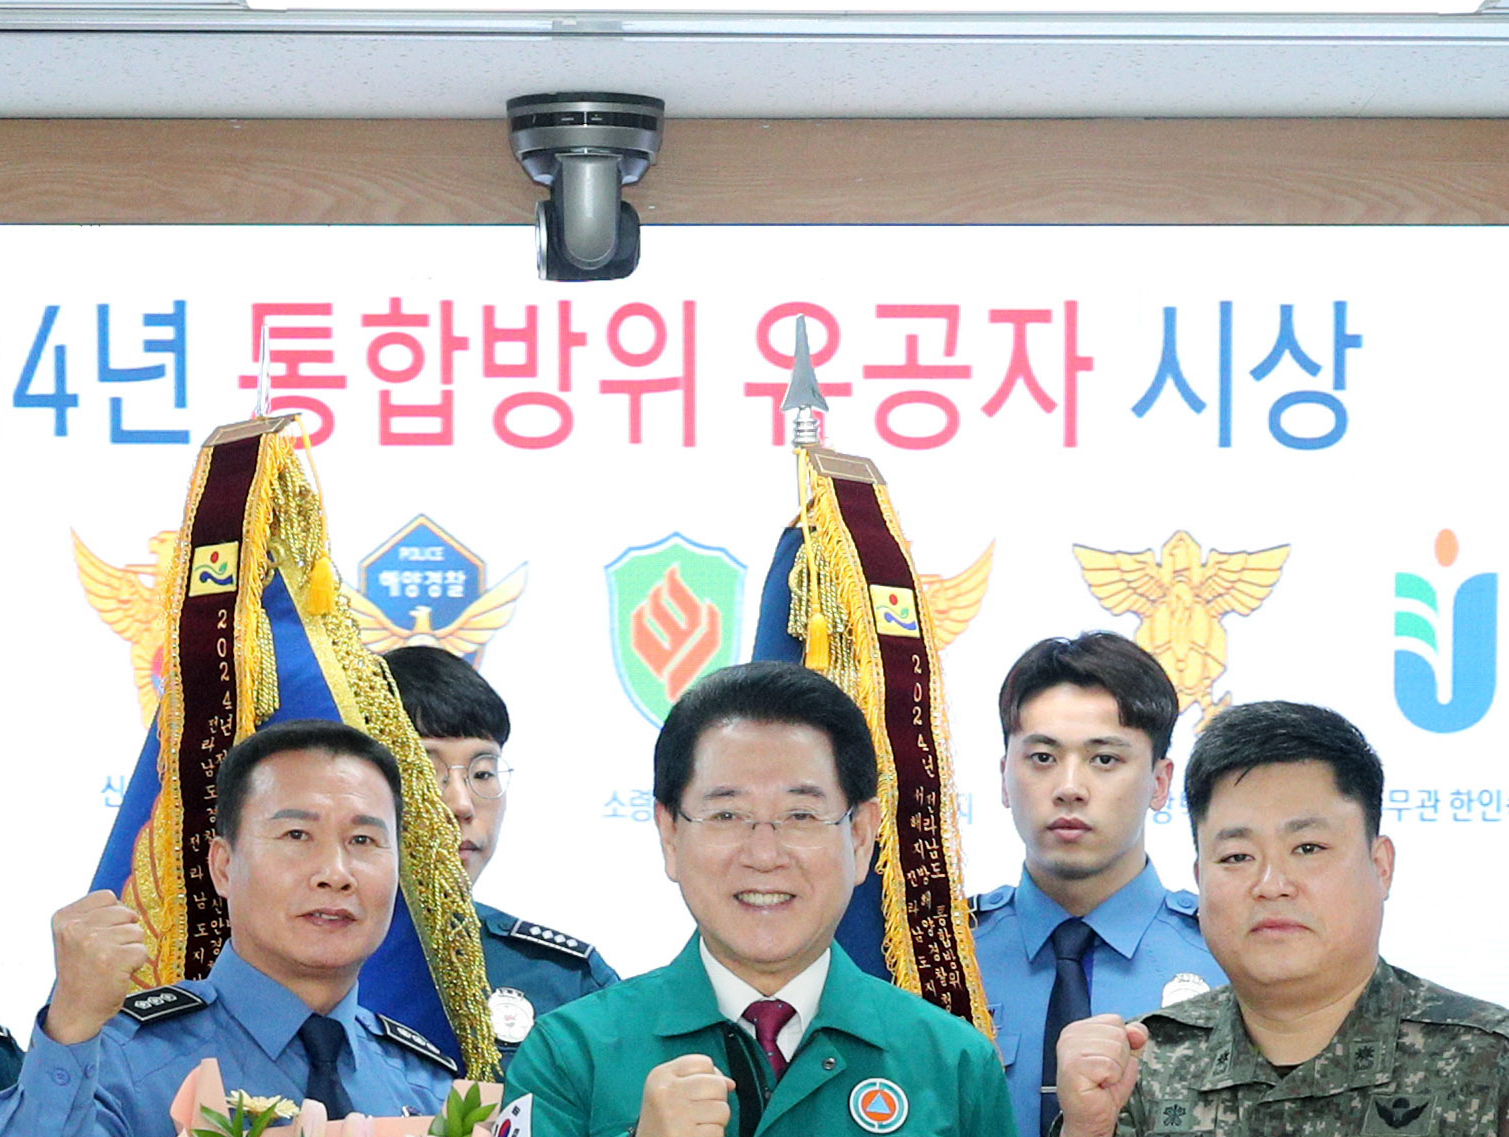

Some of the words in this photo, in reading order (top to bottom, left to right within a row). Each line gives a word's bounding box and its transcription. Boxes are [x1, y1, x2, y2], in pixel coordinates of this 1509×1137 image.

[237, 297, 698, 449] 통합방위
[743, 299, 1094, 450] 유공자
[1130, 299, 1363, 450] 시상
[378, 569, 467, 598] 해양경찰
[397, 546, 446, 562] POLICE
[215, 608, 235, 737] 2024년
[911, 654, 936, 779] 2024년
[1384, 788, 1441, 824] 무관
